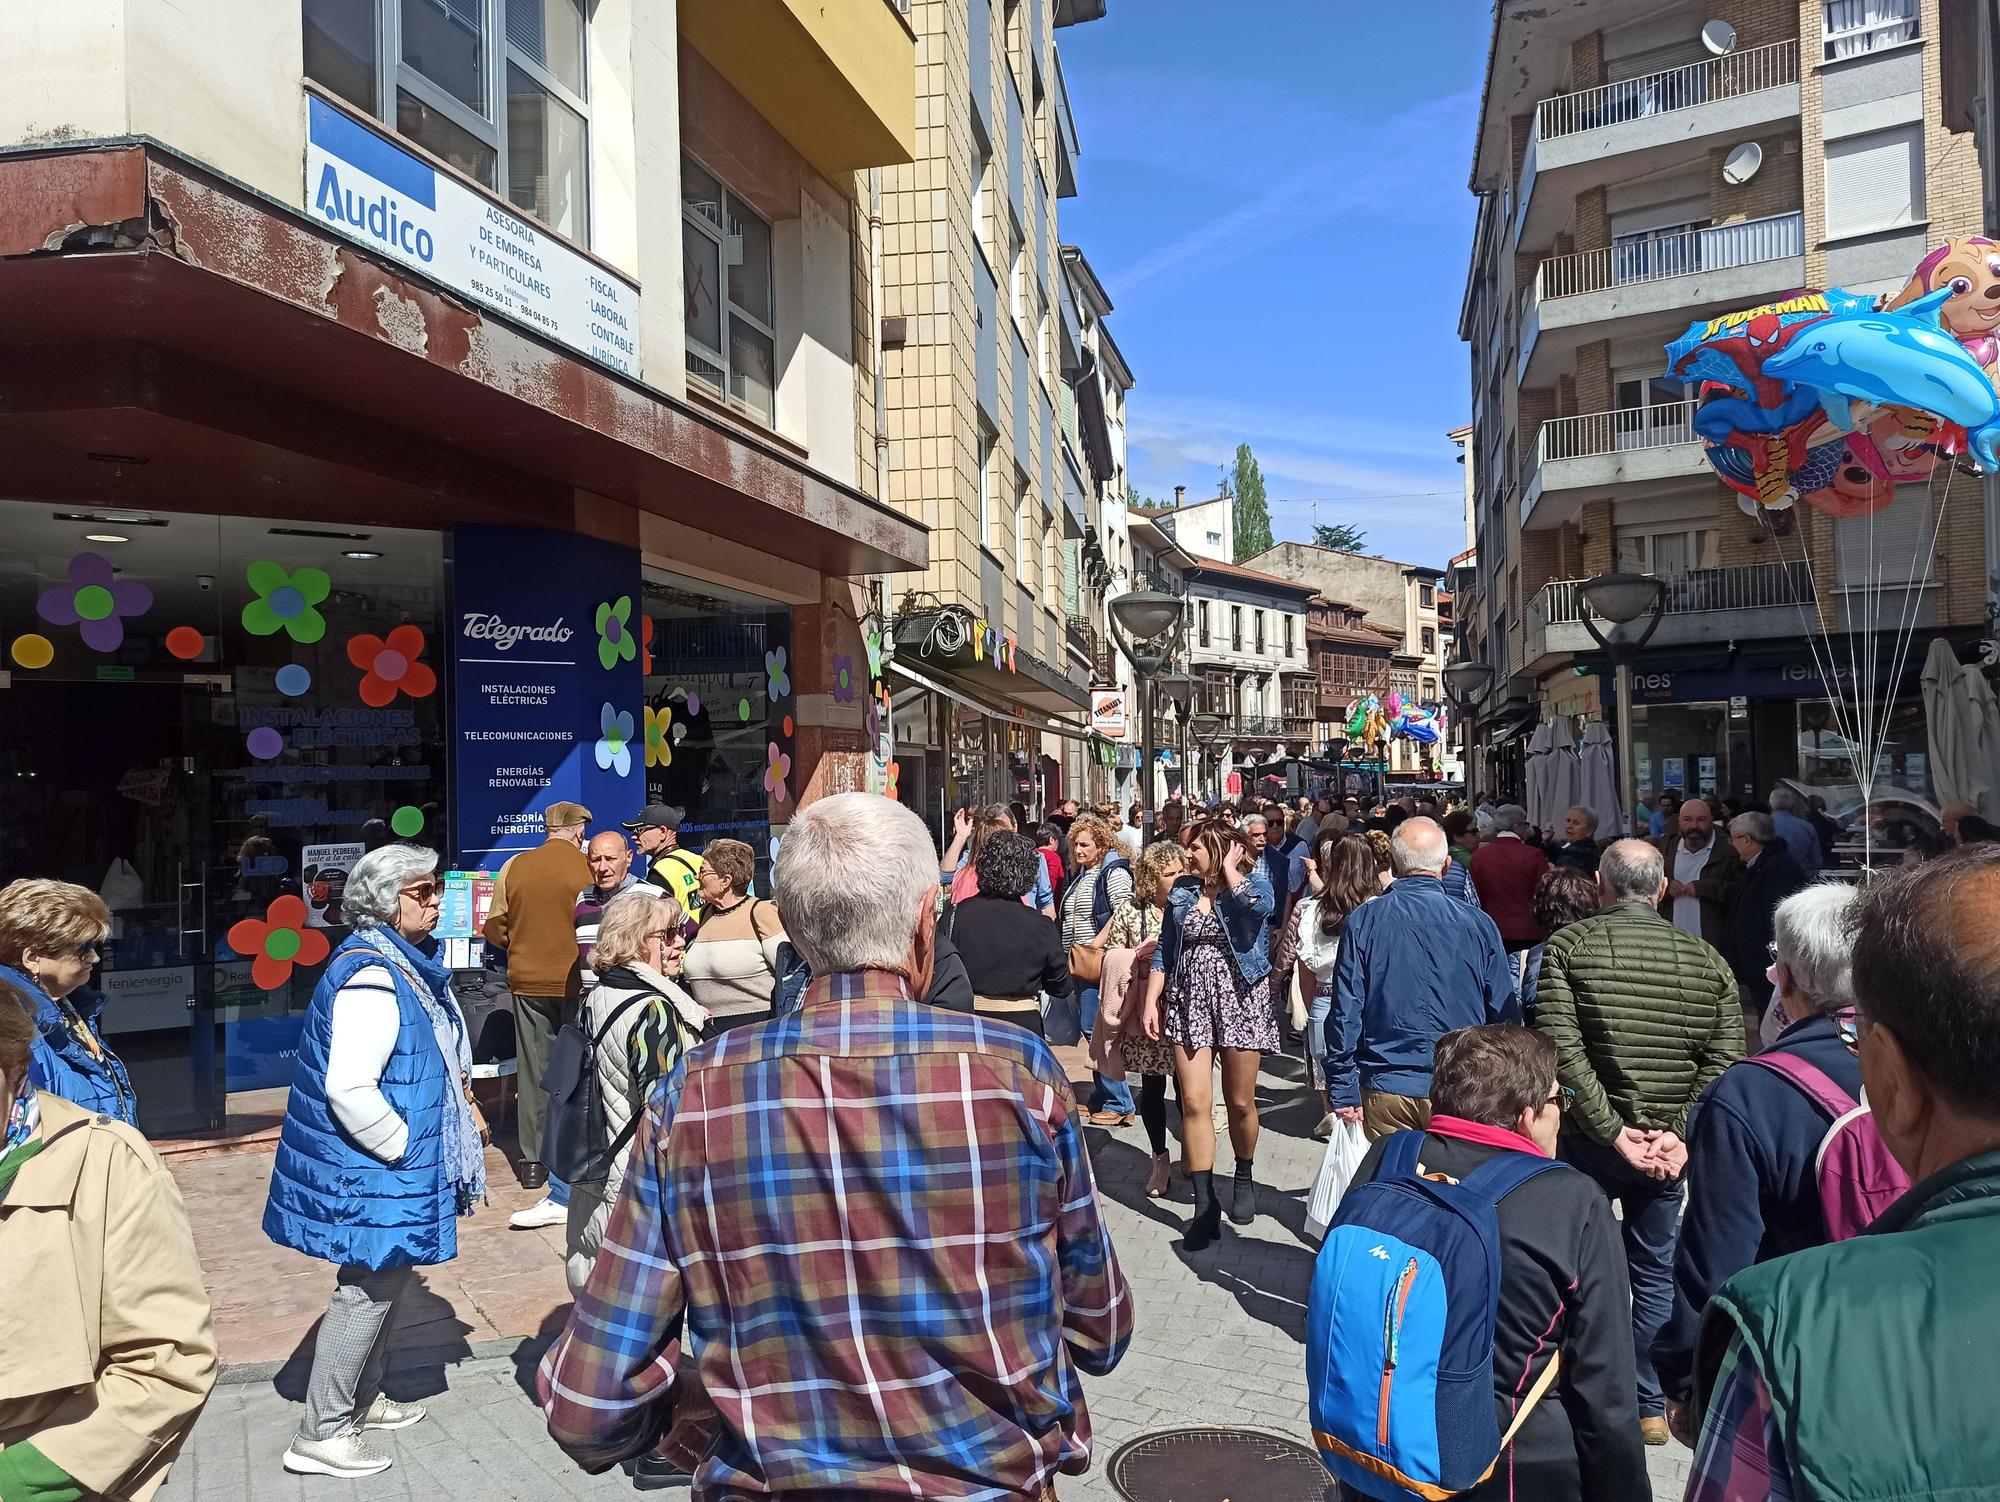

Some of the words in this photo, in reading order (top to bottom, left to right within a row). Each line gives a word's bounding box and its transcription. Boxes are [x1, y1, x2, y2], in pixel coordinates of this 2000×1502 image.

[316, 163, 434, 262] Audico
[486, 207, 535, 247] ASESORÍA
[479, 226, 493, 245] DE
[496, 236, 542, 272] EMPRESA
[469, 244, 476, 259] Y
[479, 250, 551, 299] PARTICULARES
[503, 285, 529, 304] Teléfonos
[590, 276, 618, 303] FISCAL
[471, 279, 484, 293] 985
[485, 286, 494, 298] 25
[495, 290, 504, 303] 50
[505, 296, 512, 307] 11
[520, 305, 533, 317] 984
[533, 311, 541, 321] 04
[542, 315, 550, 326] 85
[550, 319, 558, 331] 75
[591, 299, 628, 331] LABORAL
[1701, 293, 1829, 342] SPIDER-MAN
[591, 322, 634, 356] CONTABLE
[463, 613, 574, 650] Telegrado
[481, 685, 556, 694] INSTALACIONES
[1612, 672, 1671, 691] rines
[490, 694, 548, 705] ELÉCTRICAS
[1094, 697, 1122, 718] TITANLUX
[241, 708, 413, 727] INSTALACIONES
[464, 731, 573, 741] TELECOMUNICACIONES
[496, 765, 544, 777] ENERGÍAS
[489, 777, 552, 788] RENOVABLES
[497, 811, 544, 823] ASESORÍA
[490, 823, 547, 835] ENERGÉTIC
[307, 848, 331, 857] MANUEL
[333, 847, 361, 855] PEDREGAL
